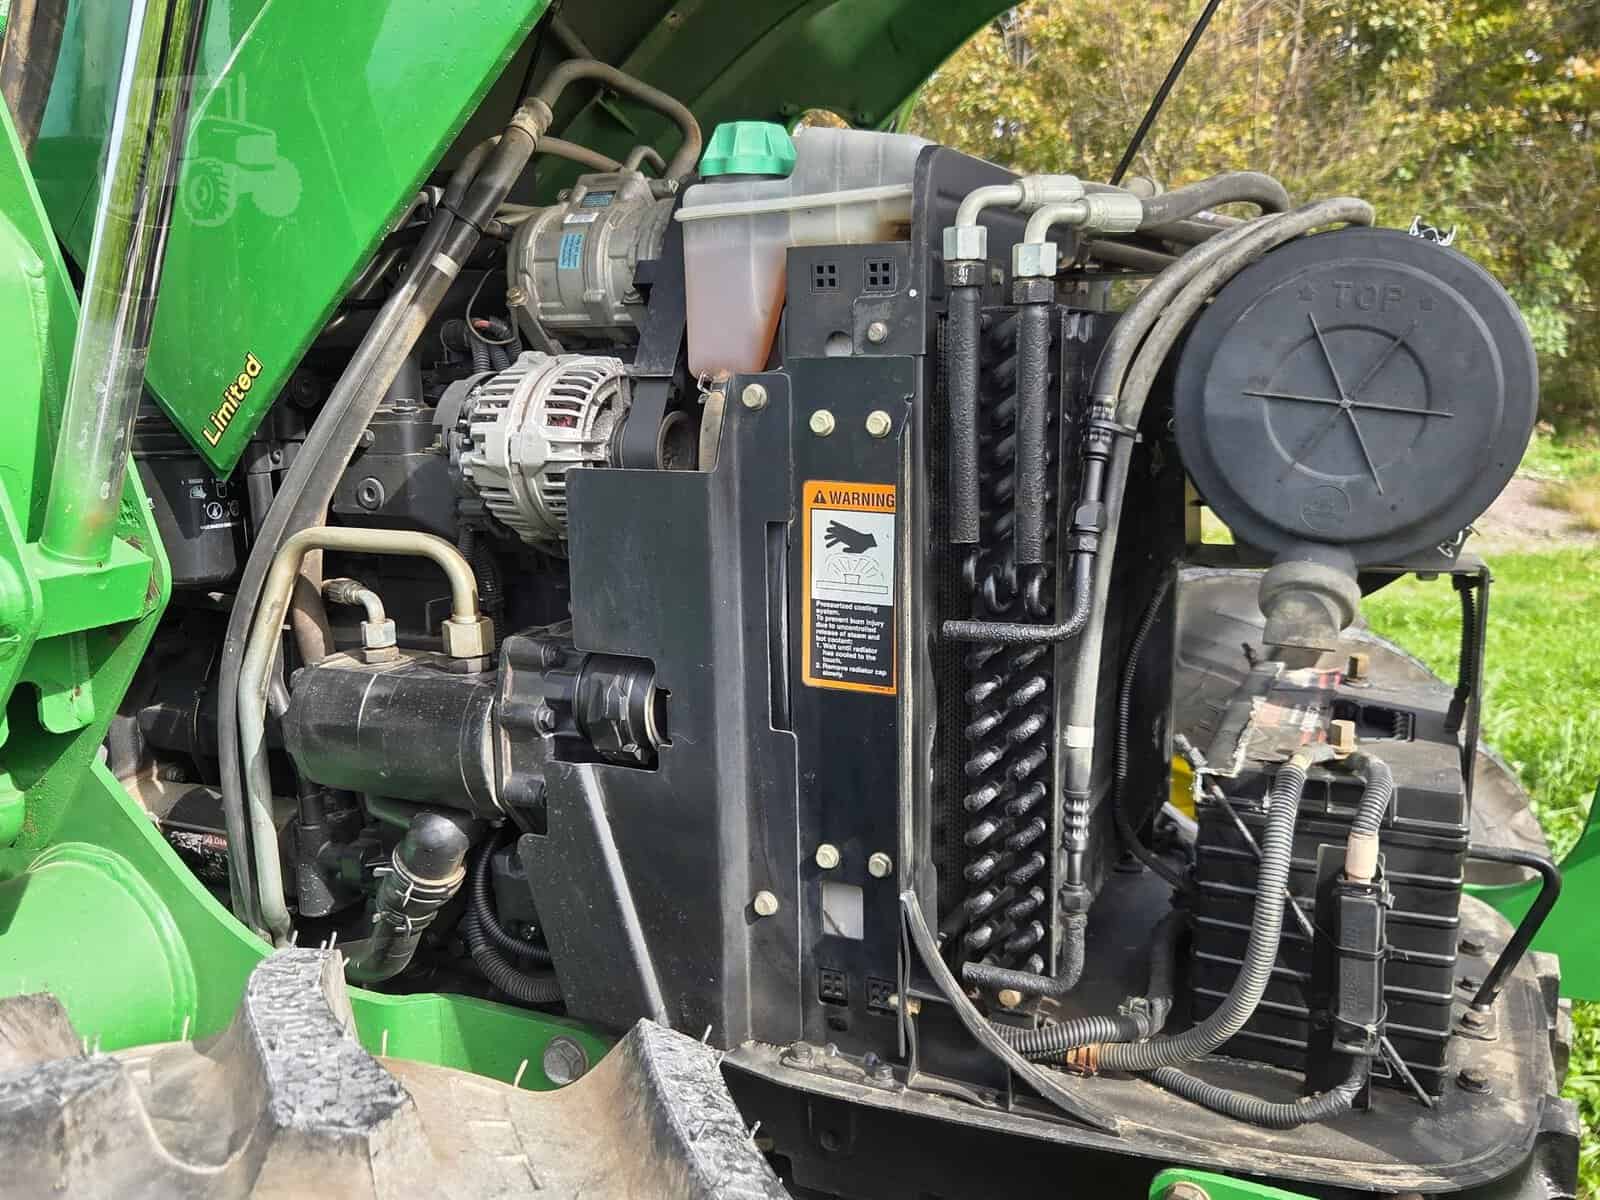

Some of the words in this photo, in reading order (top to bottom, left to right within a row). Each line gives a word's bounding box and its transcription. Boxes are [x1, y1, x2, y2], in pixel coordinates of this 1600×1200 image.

[1334, 280, 1403, 312] TOP
[202, 351, 263, 447] Limited
[828, 490, 895, 507] WARNING
[822, 642, 836, 650] Wait
[822, 663, 848, 672] Remove
